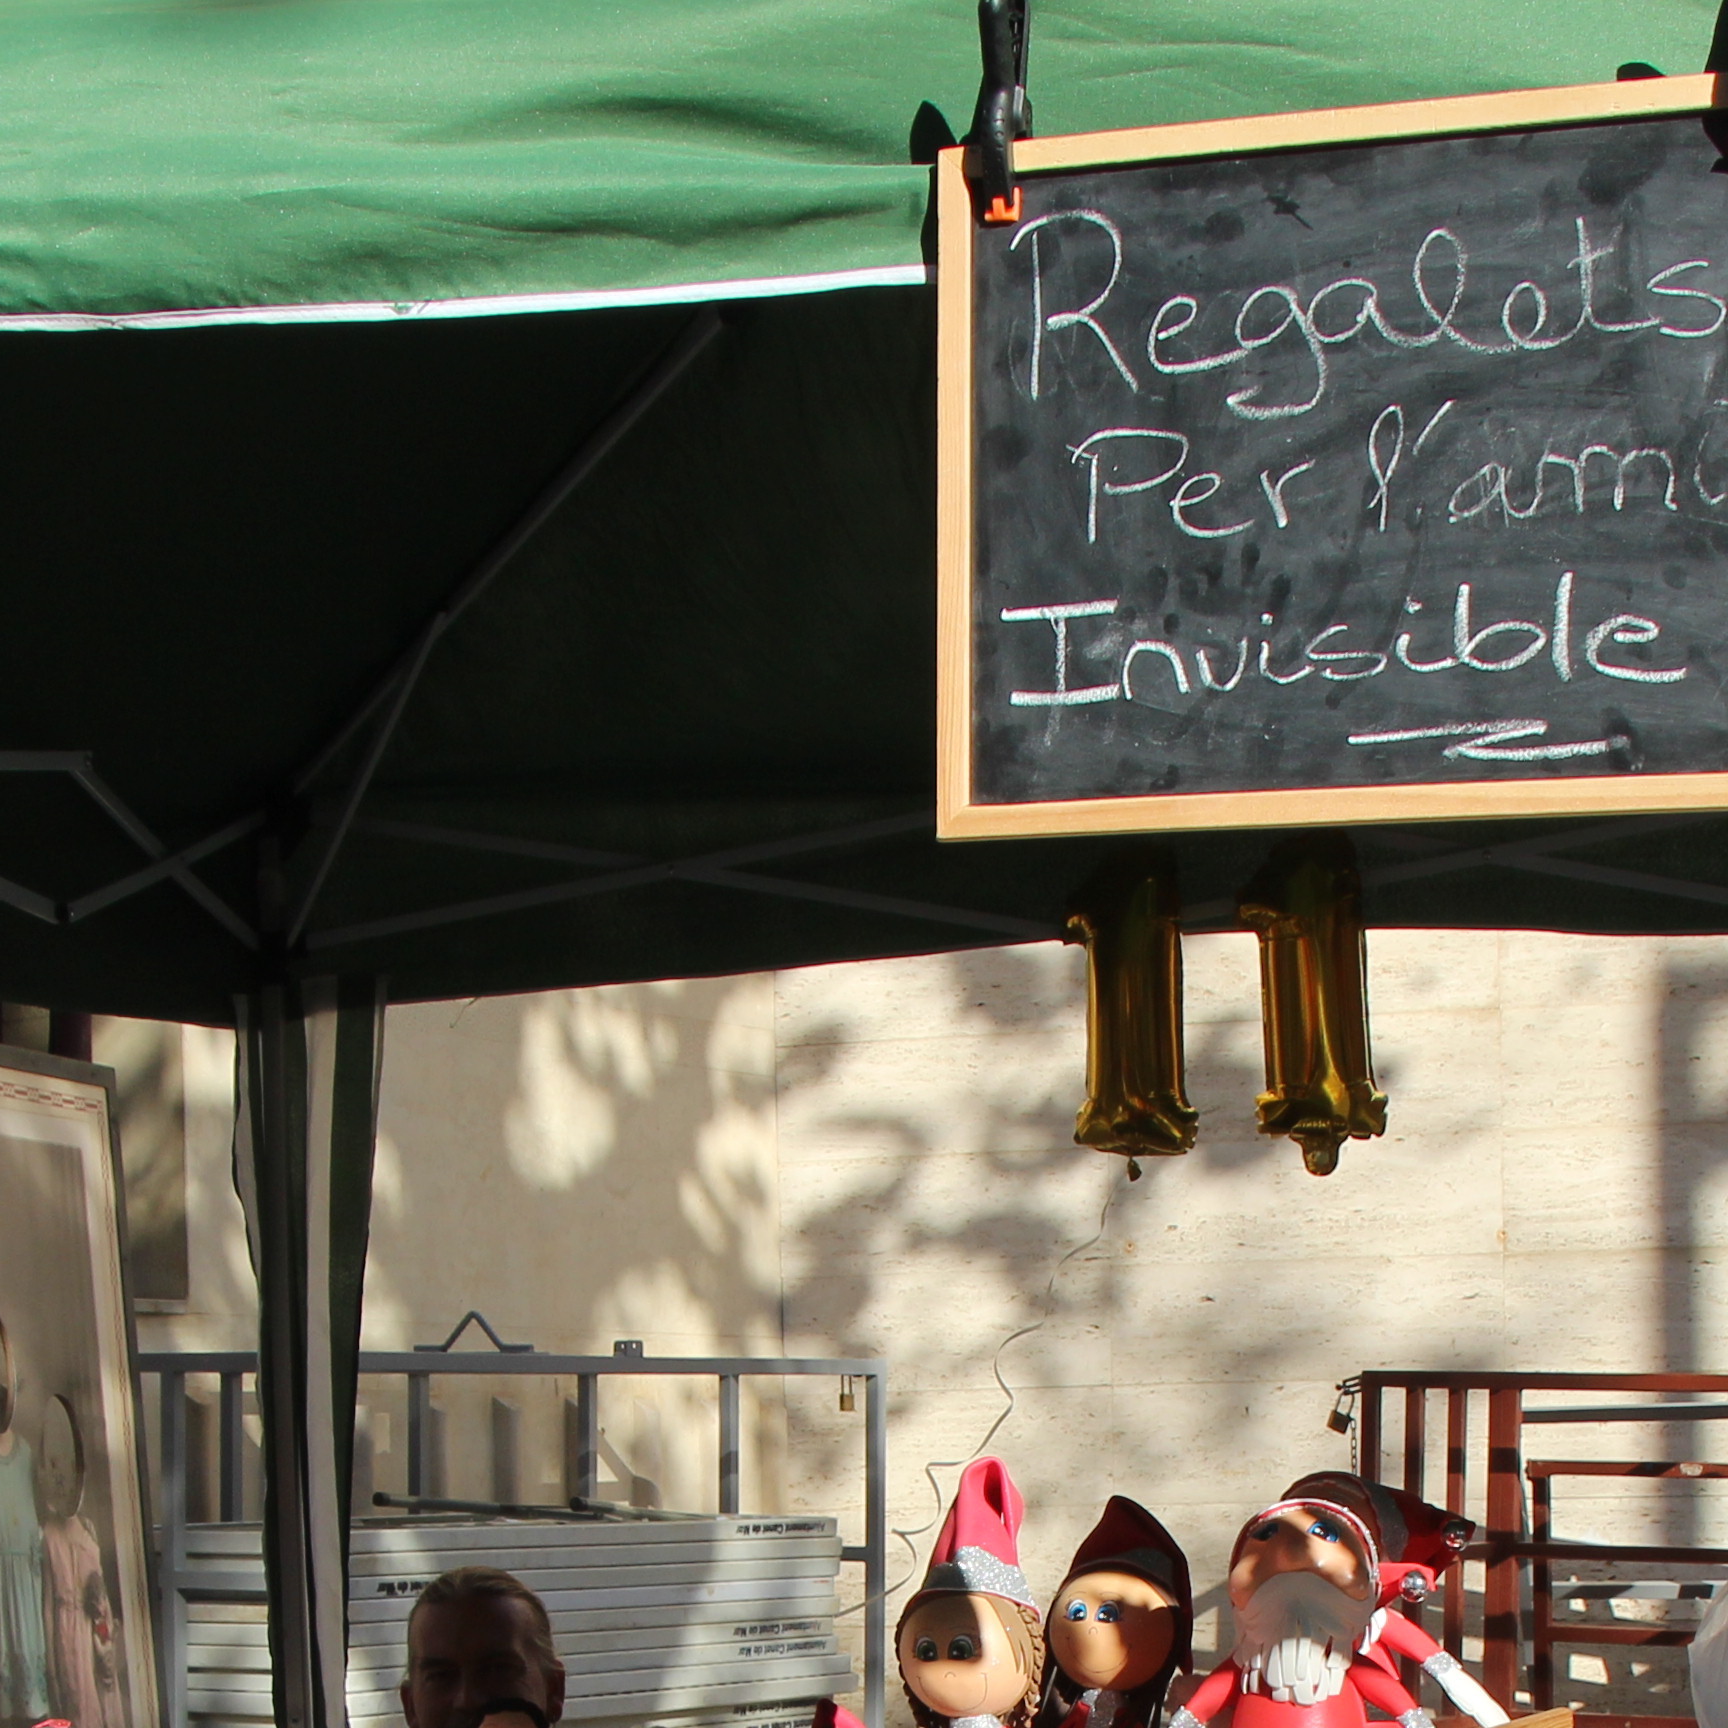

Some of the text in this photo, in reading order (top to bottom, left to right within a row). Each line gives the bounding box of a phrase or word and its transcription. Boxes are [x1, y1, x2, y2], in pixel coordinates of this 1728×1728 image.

[1010, 208, 1727, 419] Regalets
[1066, 427, 1315, 544] Per
[1000, 571, 1687, 705] Invisible
